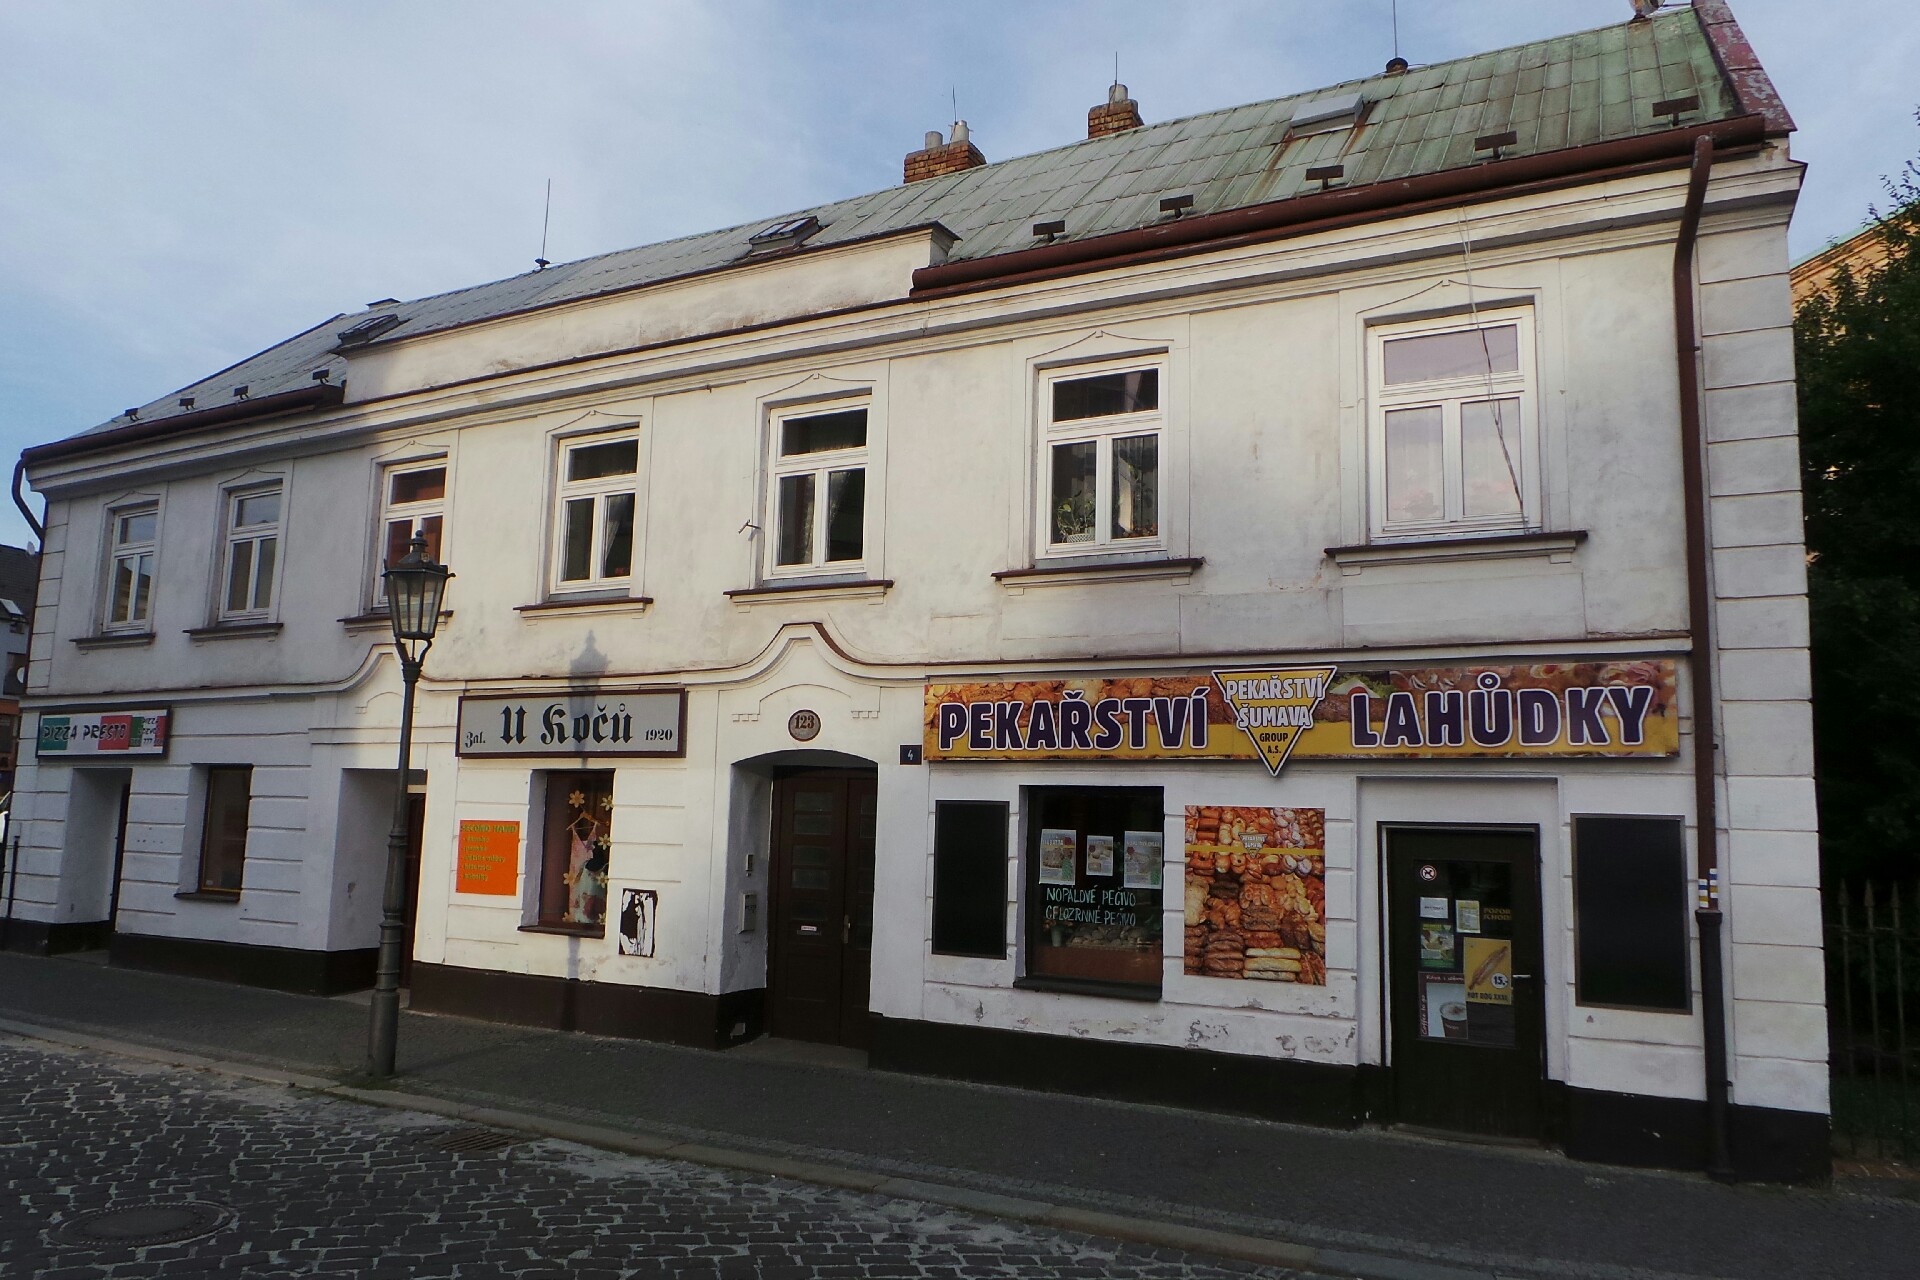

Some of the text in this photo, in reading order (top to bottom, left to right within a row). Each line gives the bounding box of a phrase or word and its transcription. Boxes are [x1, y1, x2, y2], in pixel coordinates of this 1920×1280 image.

[1225, 673, 1325, 701] PEKAŘSTVÍ
[938, 671, 1654, 750] PEKAŘSTVÍ LAHŮDKY
[1238, 703, 1312, 728] ŠUMAVA
[500, 705, 528, 744] U
[540, 702, 633, 745] Kočů
[644, 728, 673, 741] 1920
[794, 714, 815, 730] 123
[43, 724, 78, 741] PIZZA
[83, 723, 128, 741] PRESTO
[1259, 732, 1289, 743] GROUP
[907, 749, 914, 761] 4
[1267, 745, 1282, 754] A.S.
[461, 824, 517, 833] SECOND HAND
[1046, 884, 1137, 907] NOPÁLOVÉ PEČIVO
